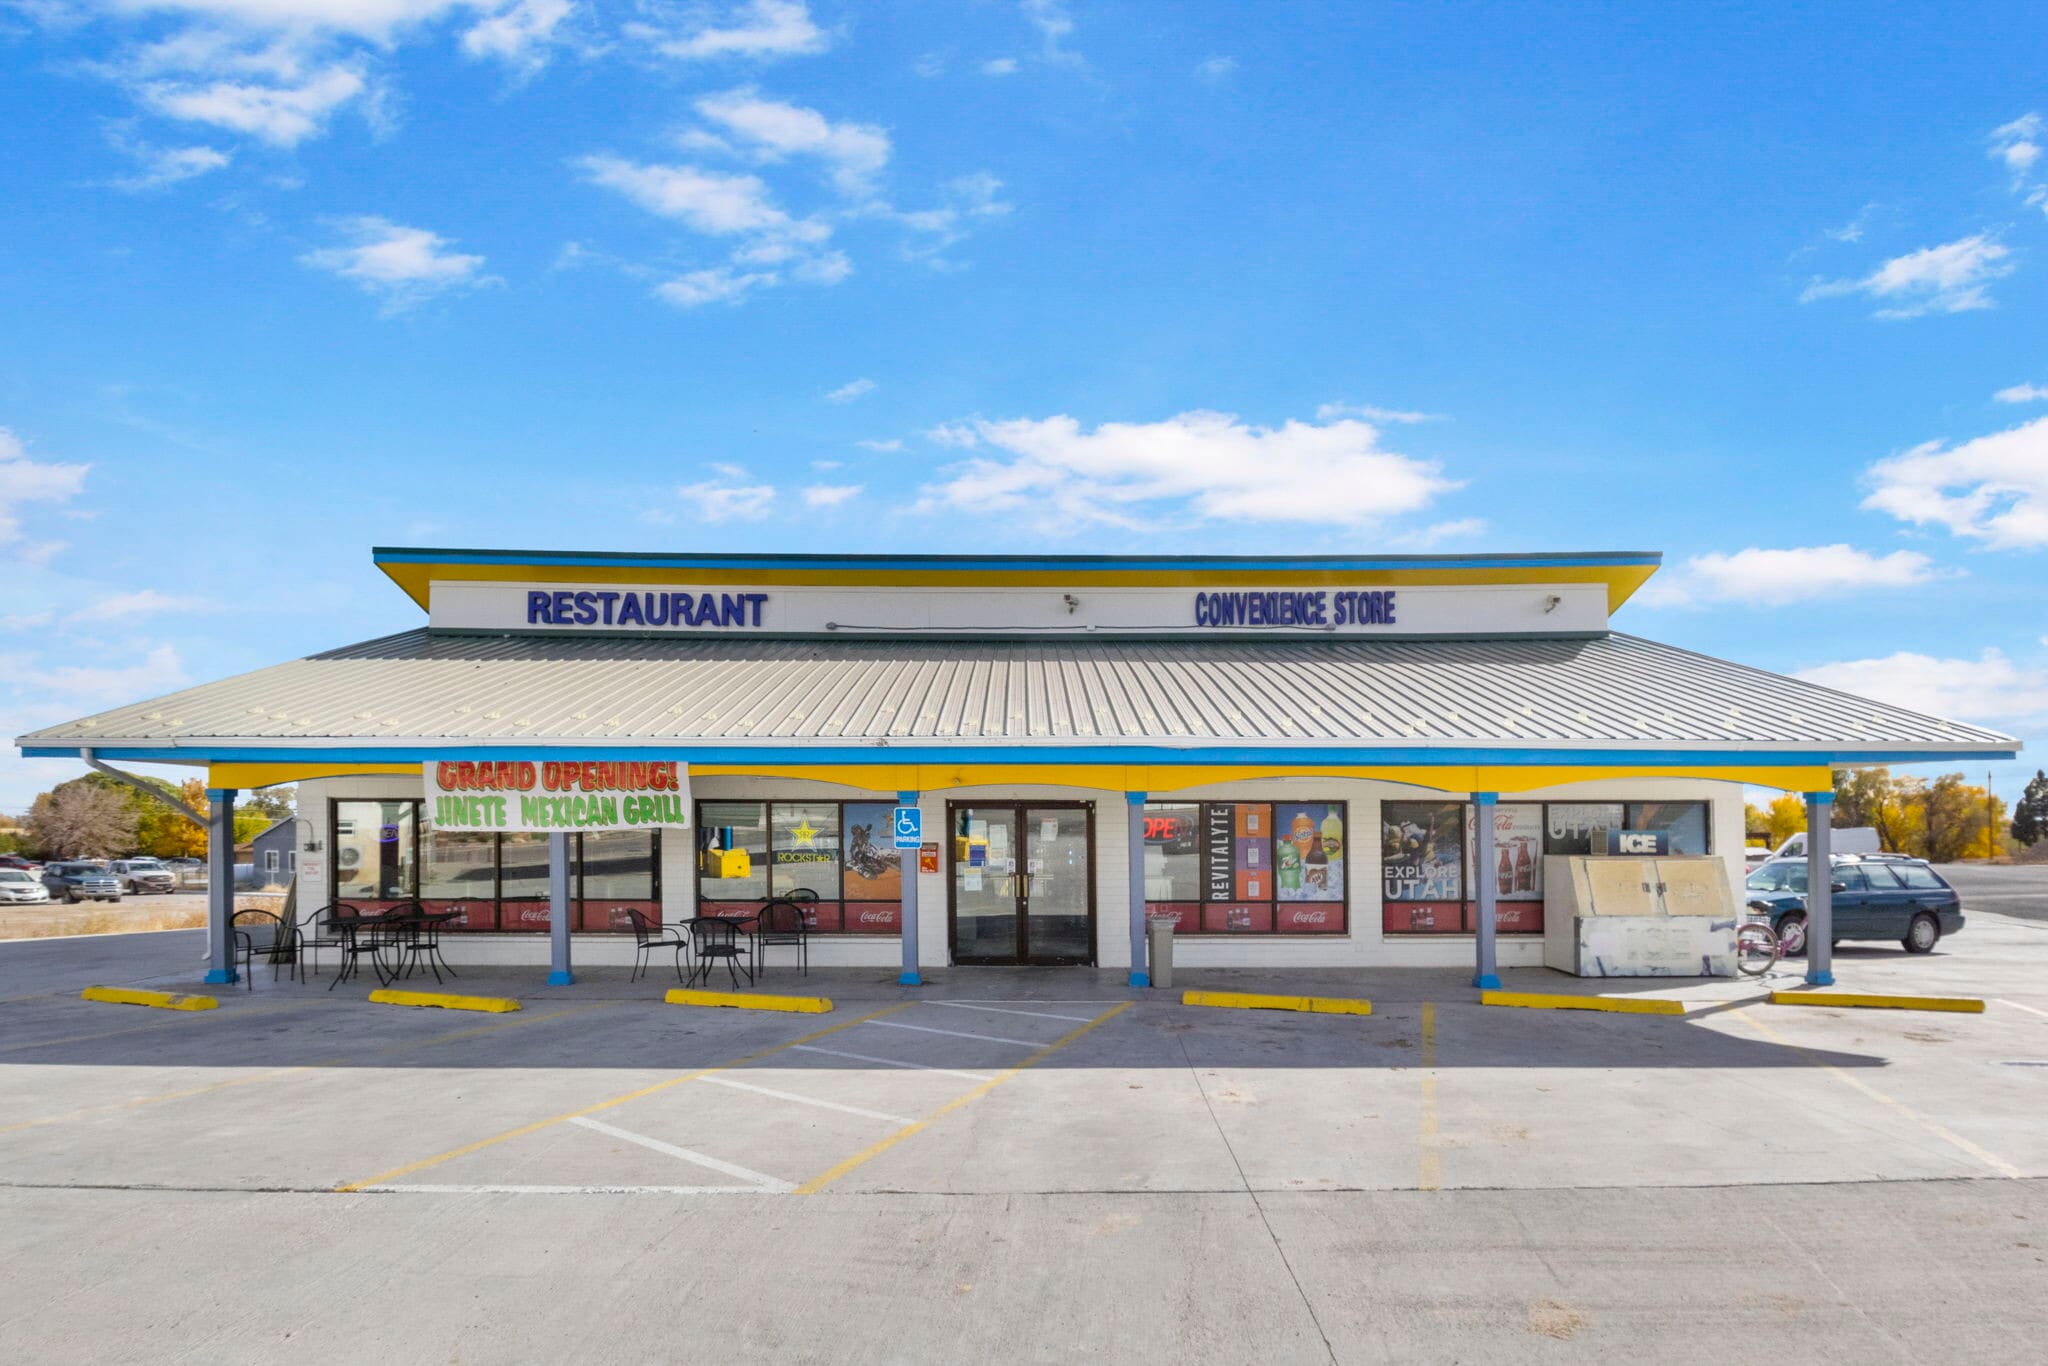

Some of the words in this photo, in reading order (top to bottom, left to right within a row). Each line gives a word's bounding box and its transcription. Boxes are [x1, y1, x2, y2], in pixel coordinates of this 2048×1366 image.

[527, 591, 768, 627] RESTAURANT
[1195, 592, 1327, 625] CONVENIENCE
[1333, 591, 1396, 625] STORE
[437, 761, 537, 792] GRAND
[542, 761, 680, 792] OPENING!
[435, 795, 508, 827] JINETE
[520, 794, 619, 828] MEXICAN
[623, 794, 685, 824] GRILL
[1211, 809, 1229, 900] REVITALYTE
[1619, 833, 1657, 853] ICE
[1384, 866, 1458, 878] EXPLORE
[1385, 879, 1459, 900] UTAH
